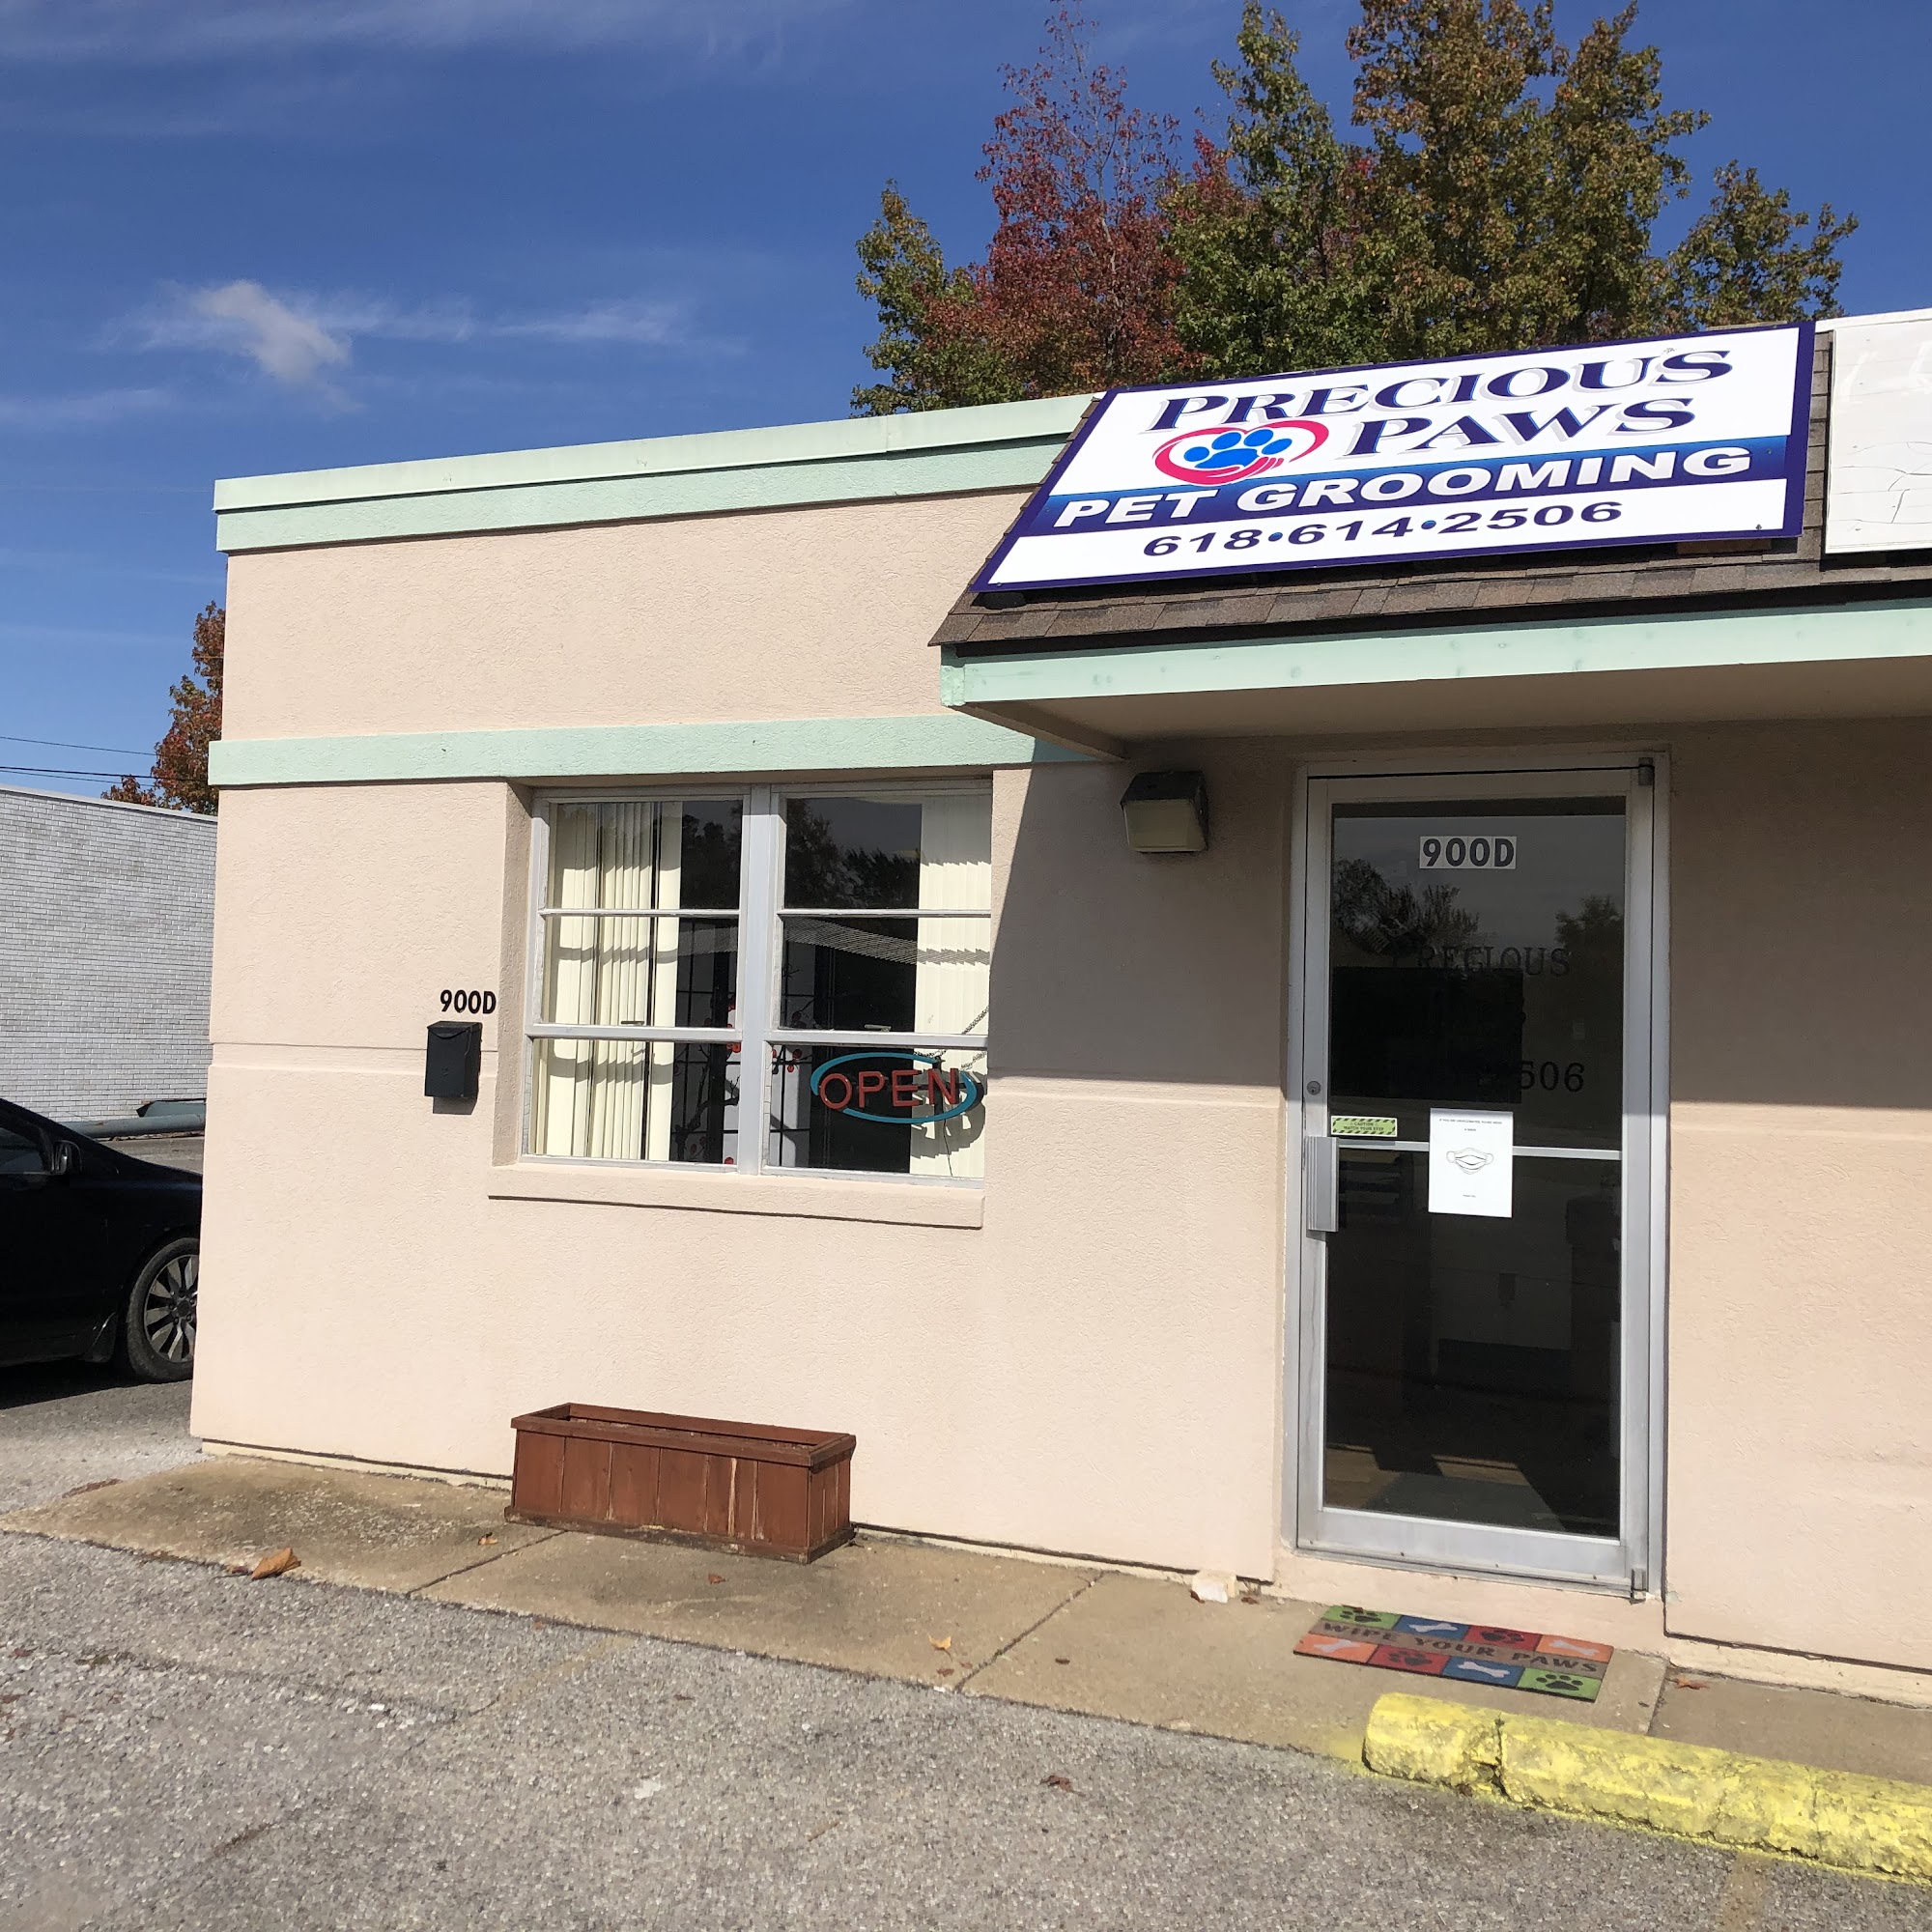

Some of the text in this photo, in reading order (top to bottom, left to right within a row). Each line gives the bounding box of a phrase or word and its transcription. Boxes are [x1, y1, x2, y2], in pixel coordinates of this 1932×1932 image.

[1140, 350, 1733, 433] PRECIOUS
[1337, 397, 1696, 459] PAWS
[1053, 446, 1752, 528] PET GROOMING
[1422, 837, 1515, 867] 900D
[1398, 946, 1571, 978] RECIOUS
[440, 989, 497, 1014] 900D
[818, 1066, 961, 1111] OPEN
[1323, 1622, 1598, 1673] WIPE YOUR PAWS
